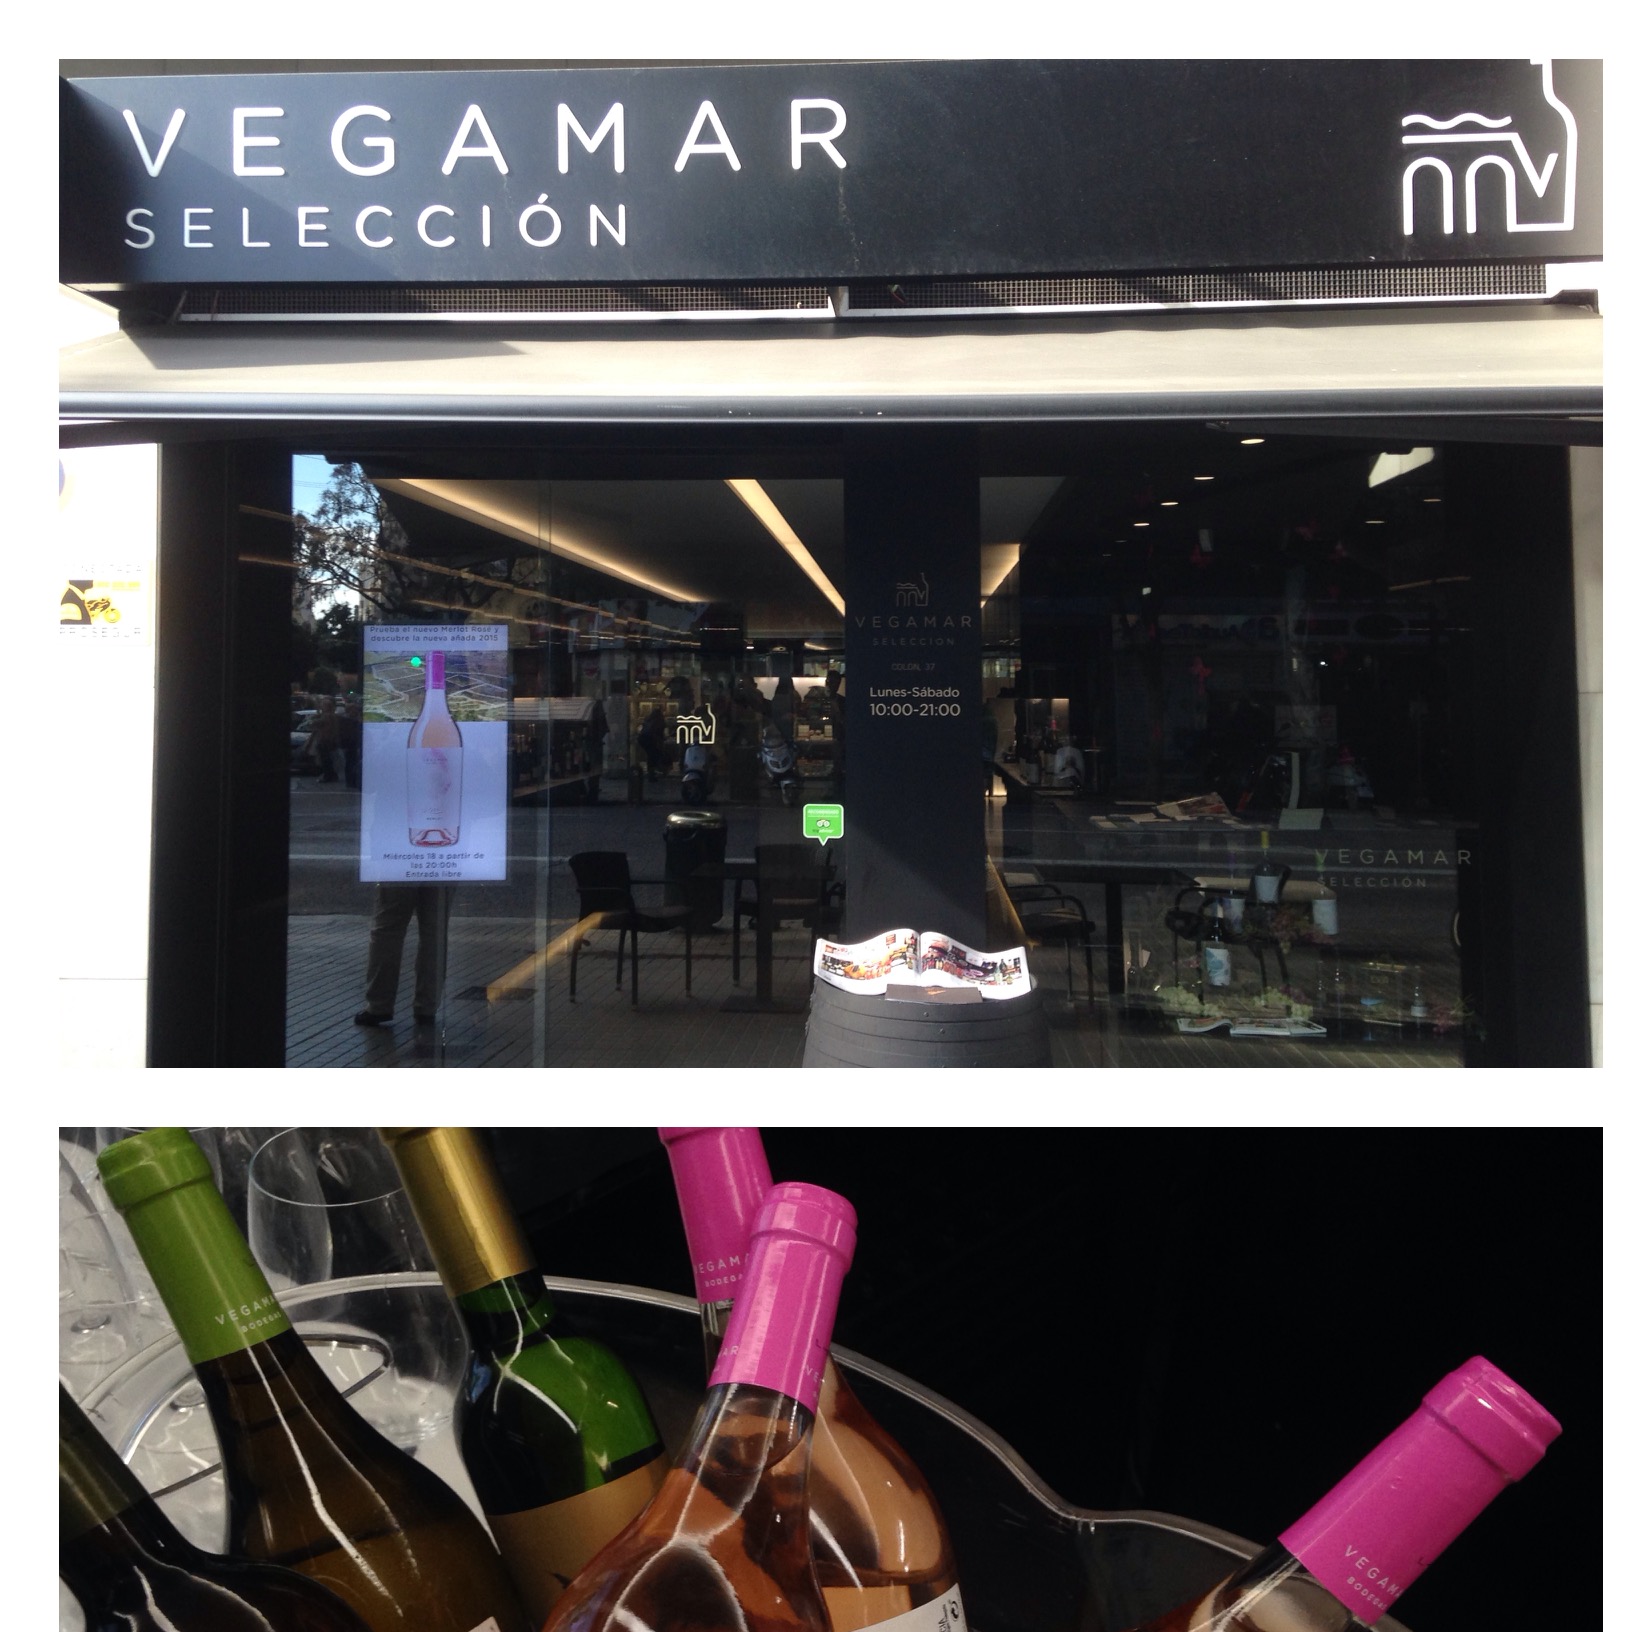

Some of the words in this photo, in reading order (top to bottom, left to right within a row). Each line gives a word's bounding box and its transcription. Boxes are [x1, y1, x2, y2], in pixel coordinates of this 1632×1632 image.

[121, 99, 850, 177] VEGAMAR
[123, 193, 627, 249] SELECCIÓN
[855, 616, 973, 628] VEGAMAR
[870, 687, 960, 697] Lunes-Sábado
[869, 703, 961, 716] 10:00-21:00
[446, 853, 471, 861] partir
[1315, 849, 1472, 865] VEGAMAR
